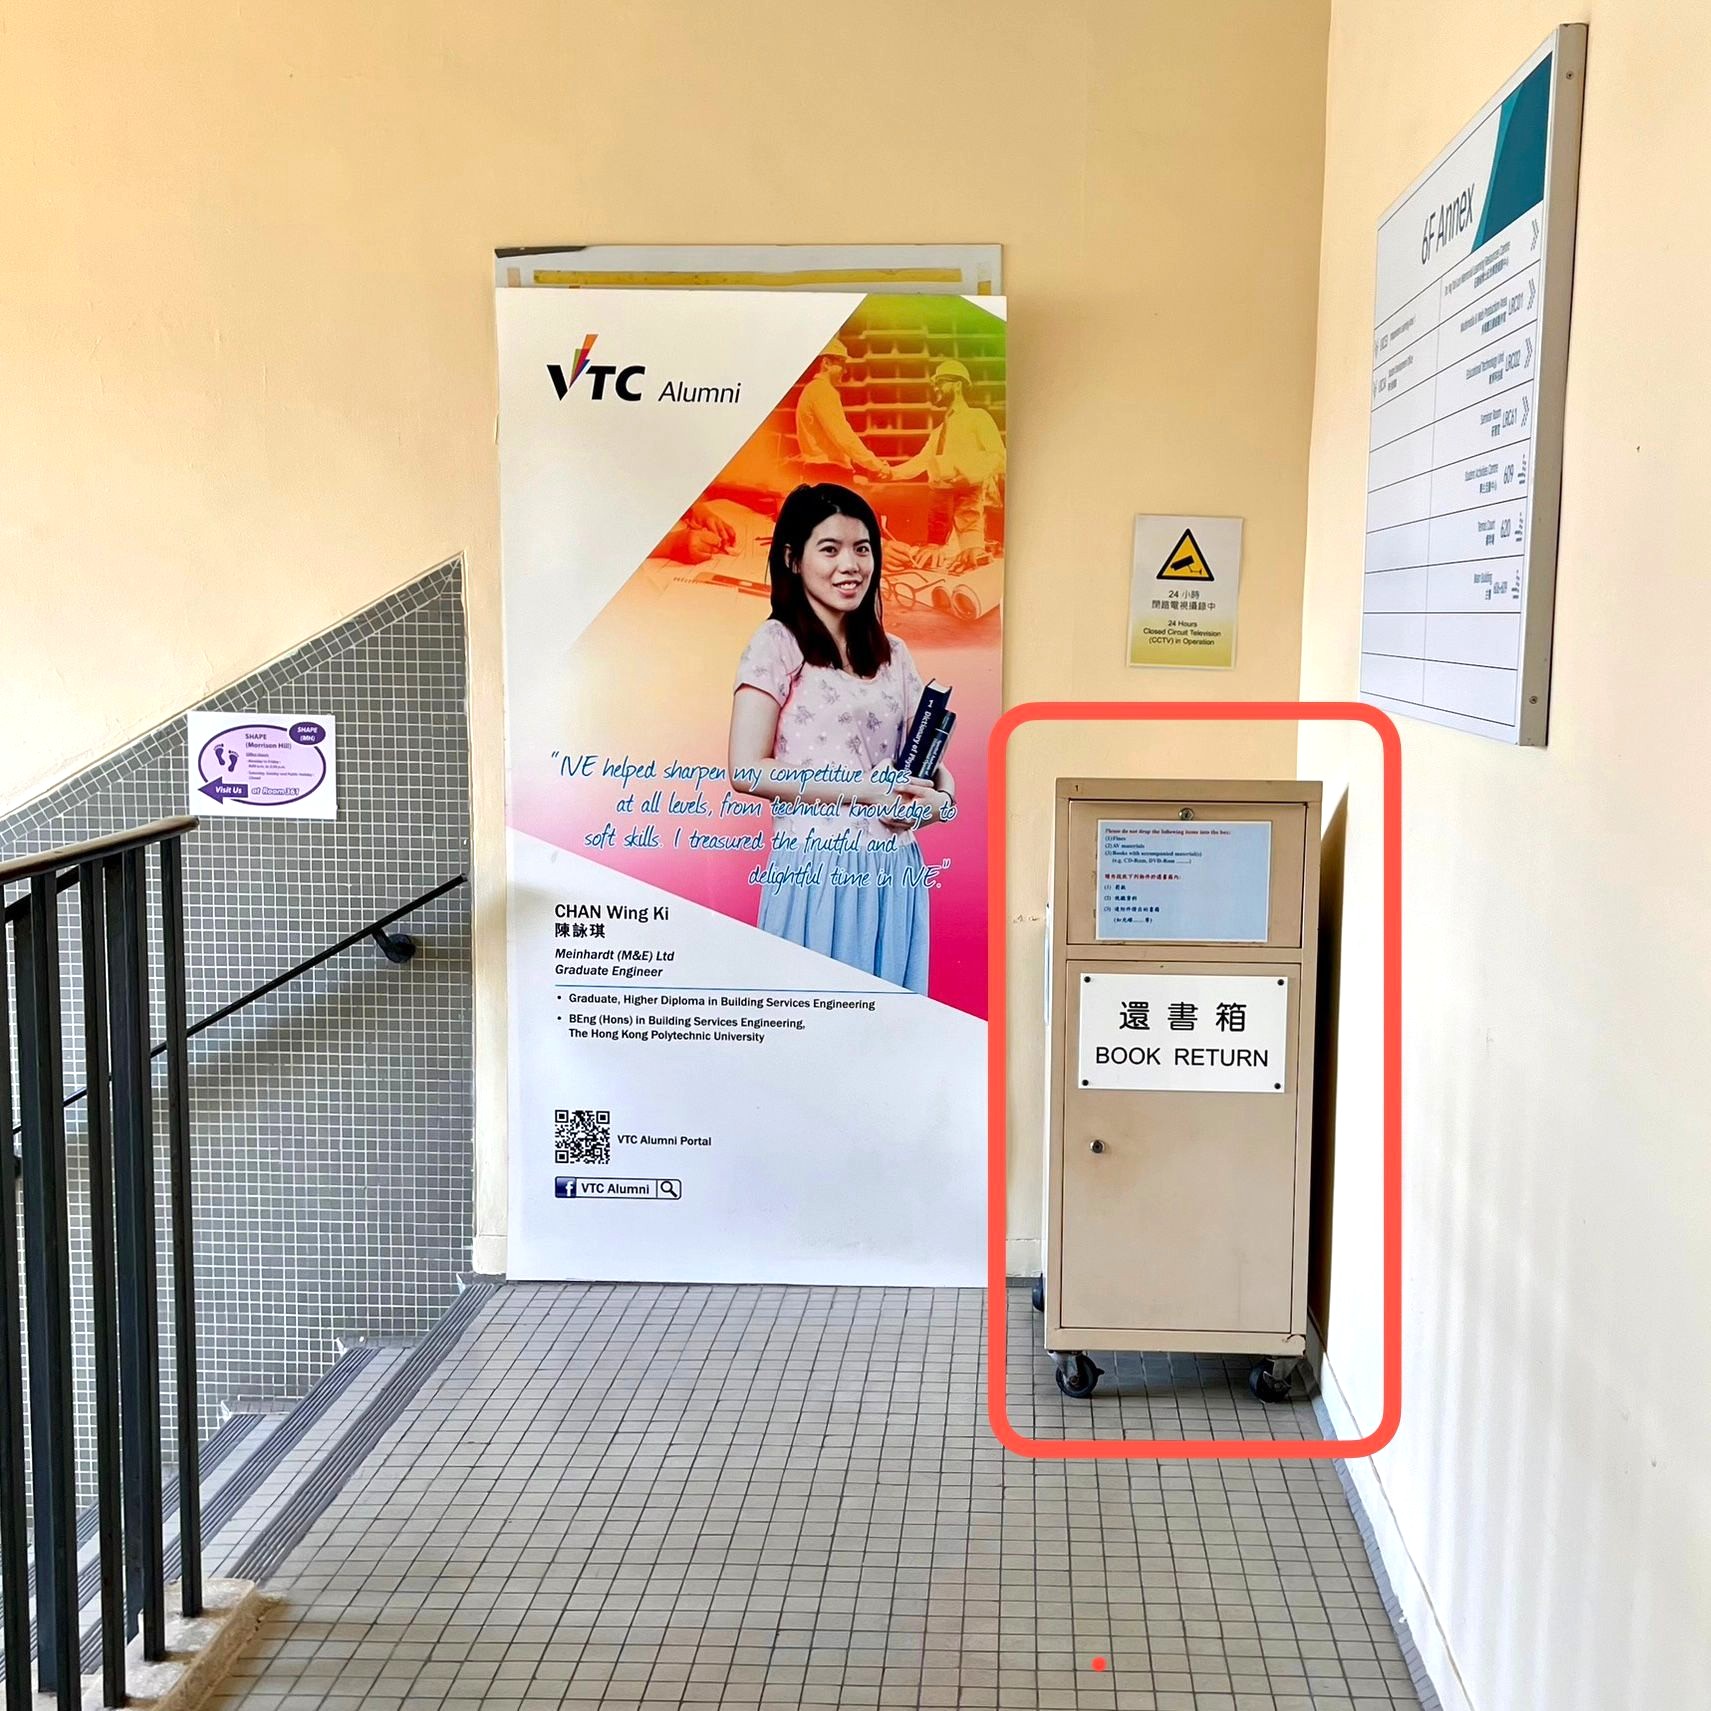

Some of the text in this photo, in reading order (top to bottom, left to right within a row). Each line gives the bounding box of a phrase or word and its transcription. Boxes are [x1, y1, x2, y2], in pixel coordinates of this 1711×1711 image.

[1421, 183, 1475, 264] 6F Annex
[546, 334, 742, 403] VTC Alumni
[1504, 464, 1514, 484] 609
[1168, 590, 1200, 599] 24 小時
[1143, 627, 1166, 635] Closed
[1190, 629, 1222, 637] Television
[1178, 620, 1198, 628] Hours
[1149, 636, 1174, 645] (CCTV)
[1183, 638, 1215, 646] Operation
[297, 726, 318, 734] SHAPE
[913, 711, 932, 744] Dictionary
[278, 742, 292, 750] Hill)
[911, 745, 918, 754] of
[603, 756, 656, 788] helped
[663, 760, 726, 791] sharpen
[734, 767, 762, 791] my
[770, 764, 863, 793] competitive
[870, 761, 911, 796] edges
[215, 786, 242, 794] Visit Us
[251, 788, 260, 796] at
[262, 788, 284, 796] Room
[617, 792, 958, 830] at all levels, from technical knowledge to
[584, 825, 897, 856] soft skills. I treasured the fruitful and
[748, 860, 822, 896] delightful
[830, 863, 871, 888] time
[877, 866, 892, 887] in
[555, 904, 669, 923] CHAN Wing Ki
[555, 923, 605, 939] 陳詠琪
[555, 949, 674, 963] Meinhardt (M&E) Ltd
[555, 965, 663, 979] Graduate Engineer
[569, 993, 876, 1011] Graduate, Higher Diploma in Building Services Engineering
[569, 1014, 805, 1030] BEng (Hons) in Building Services Engineering,
[1119, 1001, 1247, 1033] 還書箱
[569, 1028, 765, 1044] The Hong Kong Polytechnic University
[1096, 1047, 1269, 1067] BOOK RETURN
[617, 1135, 712, 1146] VTC Alumni Portal
[581, 1183, 605, 1193] VTC
[607, 1184, 649, 1195] Alumni
